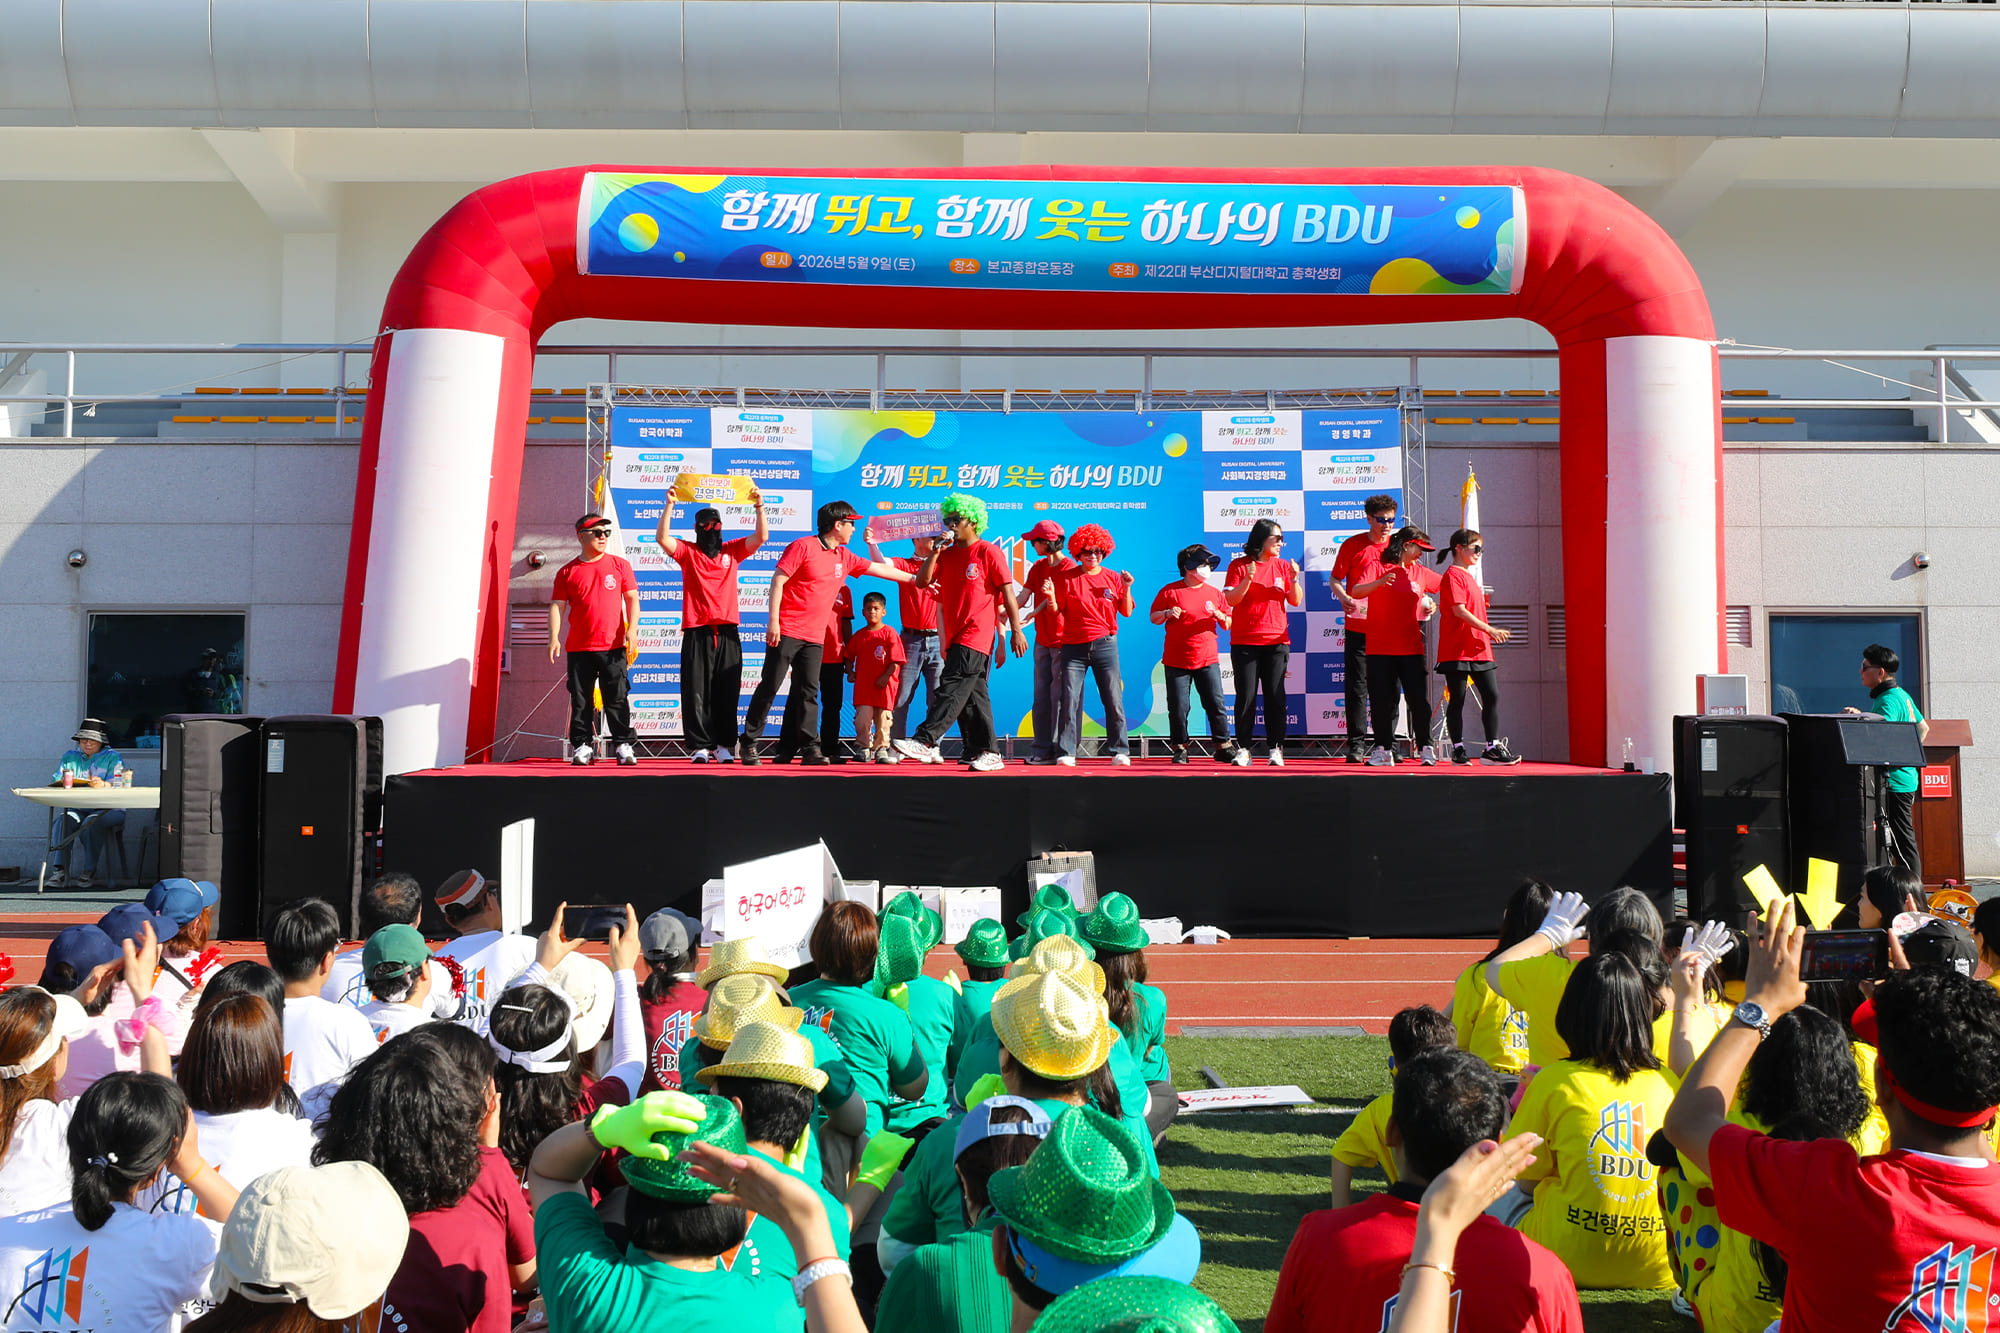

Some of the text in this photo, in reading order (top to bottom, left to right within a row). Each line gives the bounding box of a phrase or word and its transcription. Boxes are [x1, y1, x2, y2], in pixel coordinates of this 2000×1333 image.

[721, 189, 1393, 247] 함께 뛰고, 함께 웃는 하나의 BDU
[765, 253, 916, 271] 일시 2026년 5월 9일(토)
[954, 260, 1075, 275] 장소 본교종합운동장
[1113, 265, 1341, 281] 주최 제22대 부산디지털대학교 총학생회
[640, 427, 683, 437] 한국어학과
[861, 463, 1163, 489] 함께 뛰고, 함께 웃는 하나의 BDU
[1221, 471, 1286, 480] 사회복지경영학과
[694, 487, 735, 500] 경영학과
[895, 502, 919, 510] 2026년
[986, 502, 1023, 510] 교종합운동장
[1924, 775, 1948, 784] BDU
[738, 886, 806, 922] 한국어학과
[1598, 1153, 1653, 1181] BDU
